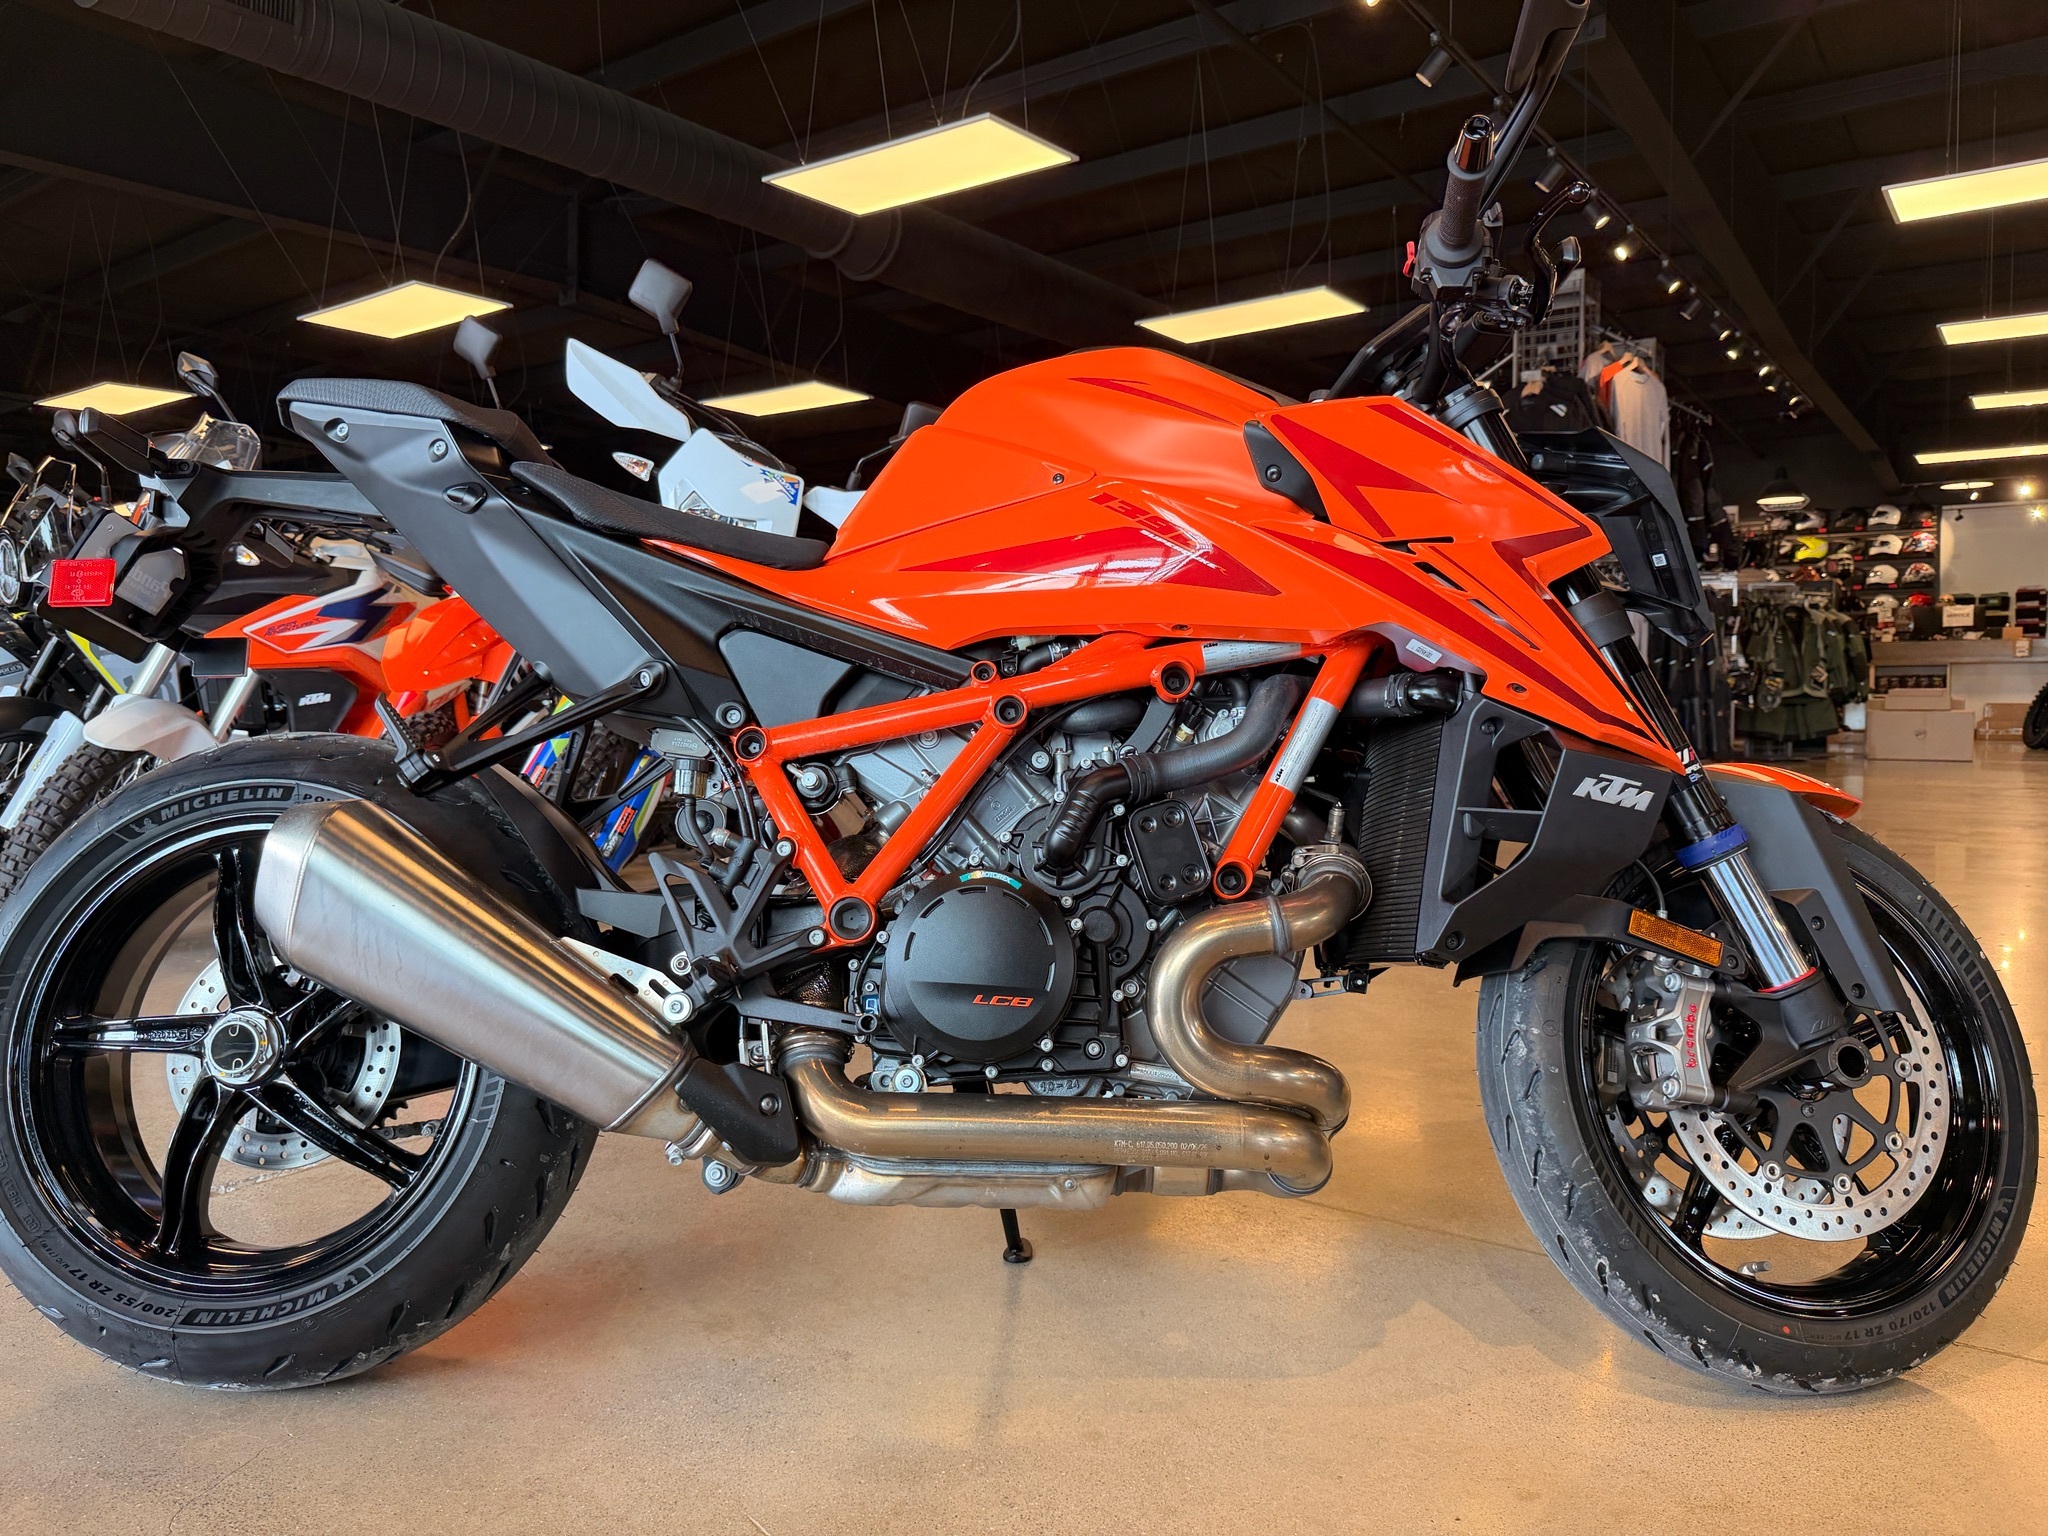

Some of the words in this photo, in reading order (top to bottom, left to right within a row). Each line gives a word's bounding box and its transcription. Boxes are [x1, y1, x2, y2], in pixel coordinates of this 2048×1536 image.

[298, 692, 331, 706] KTM
[160, 786, 284, 821] MICHELIN
[1572, 773, 1655, 812] KTM
[973, 994, 1034, 1008] LC8
[1685, 1003, 1698, 1068] brembo
[1944, 1216, 2005, 1300] MICHELIN
[69, 1268, 87, 1281] 17
[88, 1279, 113, 1296] ZR
[113, 1292, 177, 1319] 200/55
[193, 1287, 328, 1324] MICHELIN
[1889, 1301, 1937, 1331] 120/70
[1845, 1331, 1860, 1341] 17
[1865, 1325, 1884, 1338] ZR
